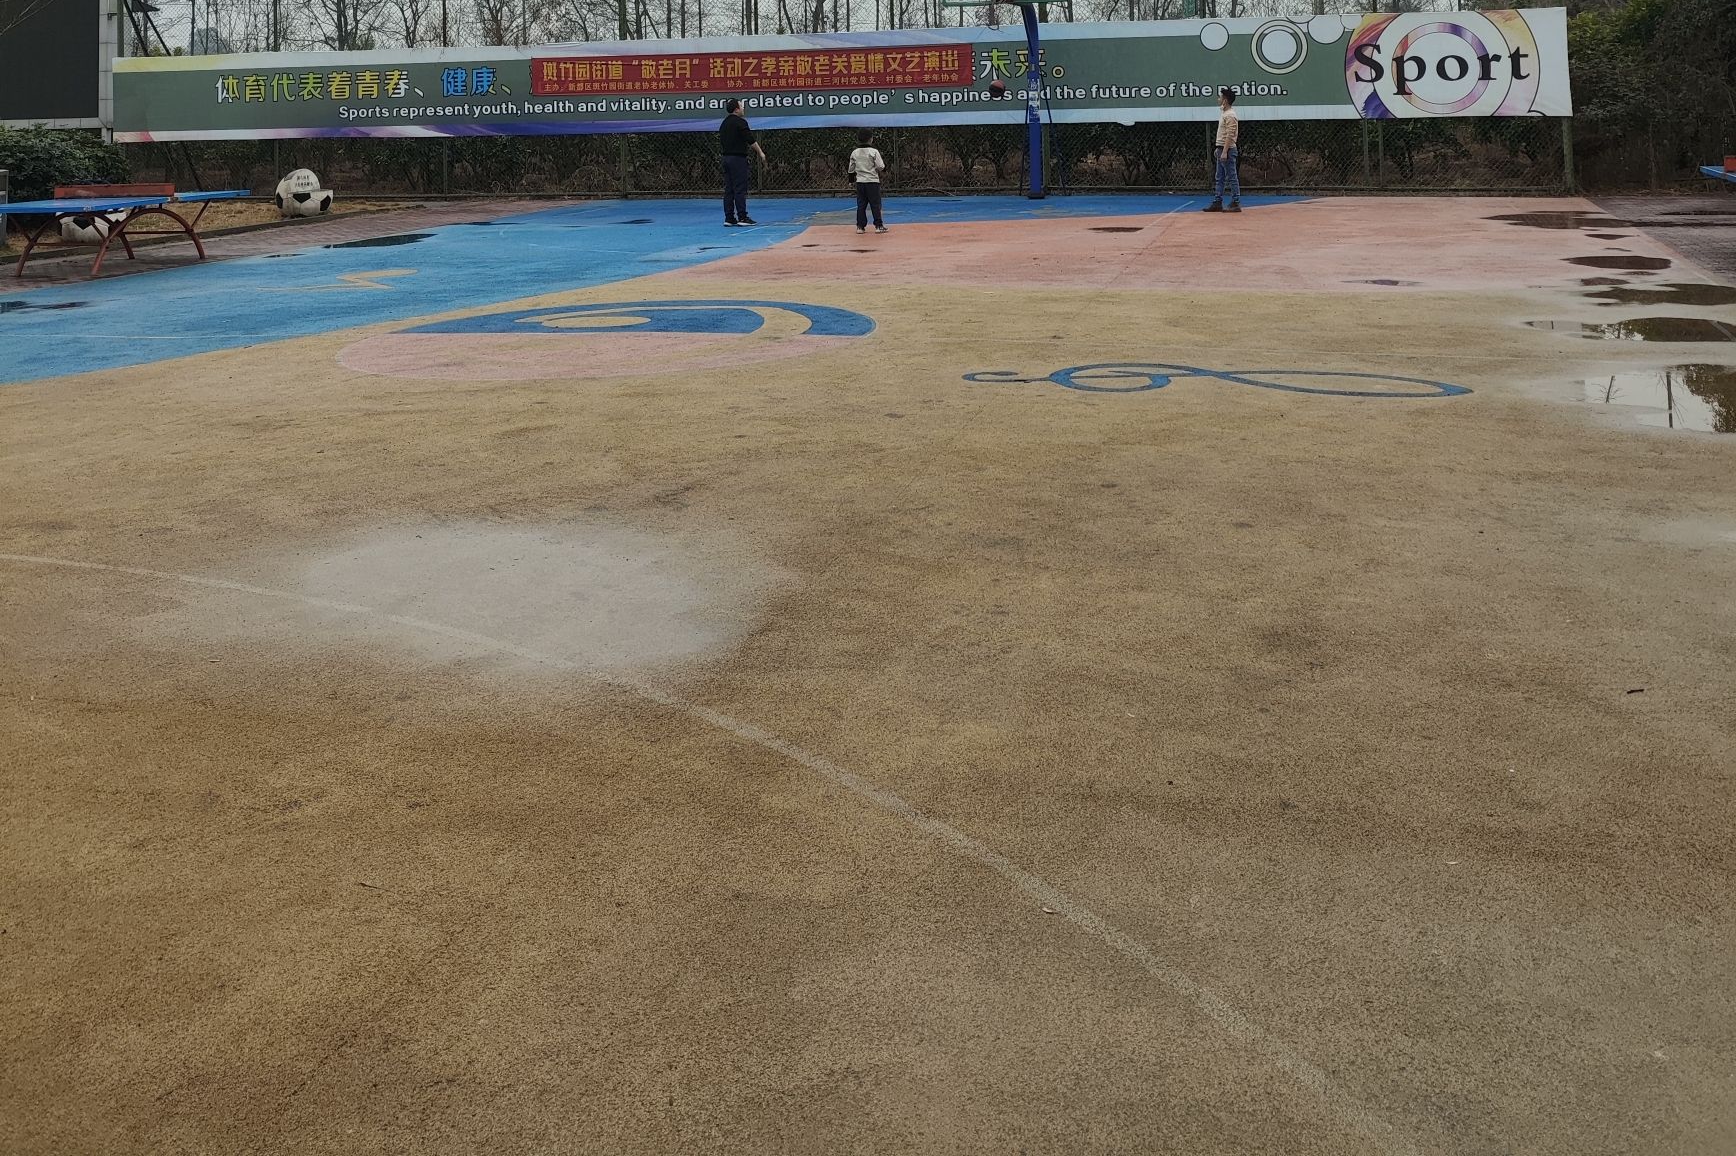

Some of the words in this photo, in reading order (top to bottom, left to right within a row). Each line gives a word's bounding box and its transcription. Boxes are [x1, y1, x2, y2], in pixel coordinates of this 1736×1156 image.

[1353, 43, 1531, 96] Sport
[338, 105, 390, 121] Sports
[393, 102, 470, 120] represent
[472, 100, 522, 118] youth,
[524, 98, 574, 114] health
[577, 97, 607, 113] and
[674, 95, 705, 110] and
[708, 99, 733, 109] ar
[741, 93, 803, 109] related
[807, 93, 825, 107] to
[918, 88, 1013, 107] happines
[1017, 85, 1051, 101] ad
[1055, 84, 1086, 100] the
[1090, 83, 1151, 99] future
[1155, 82, 1177, 97] of
[1180, 81, 1213, 97] the
